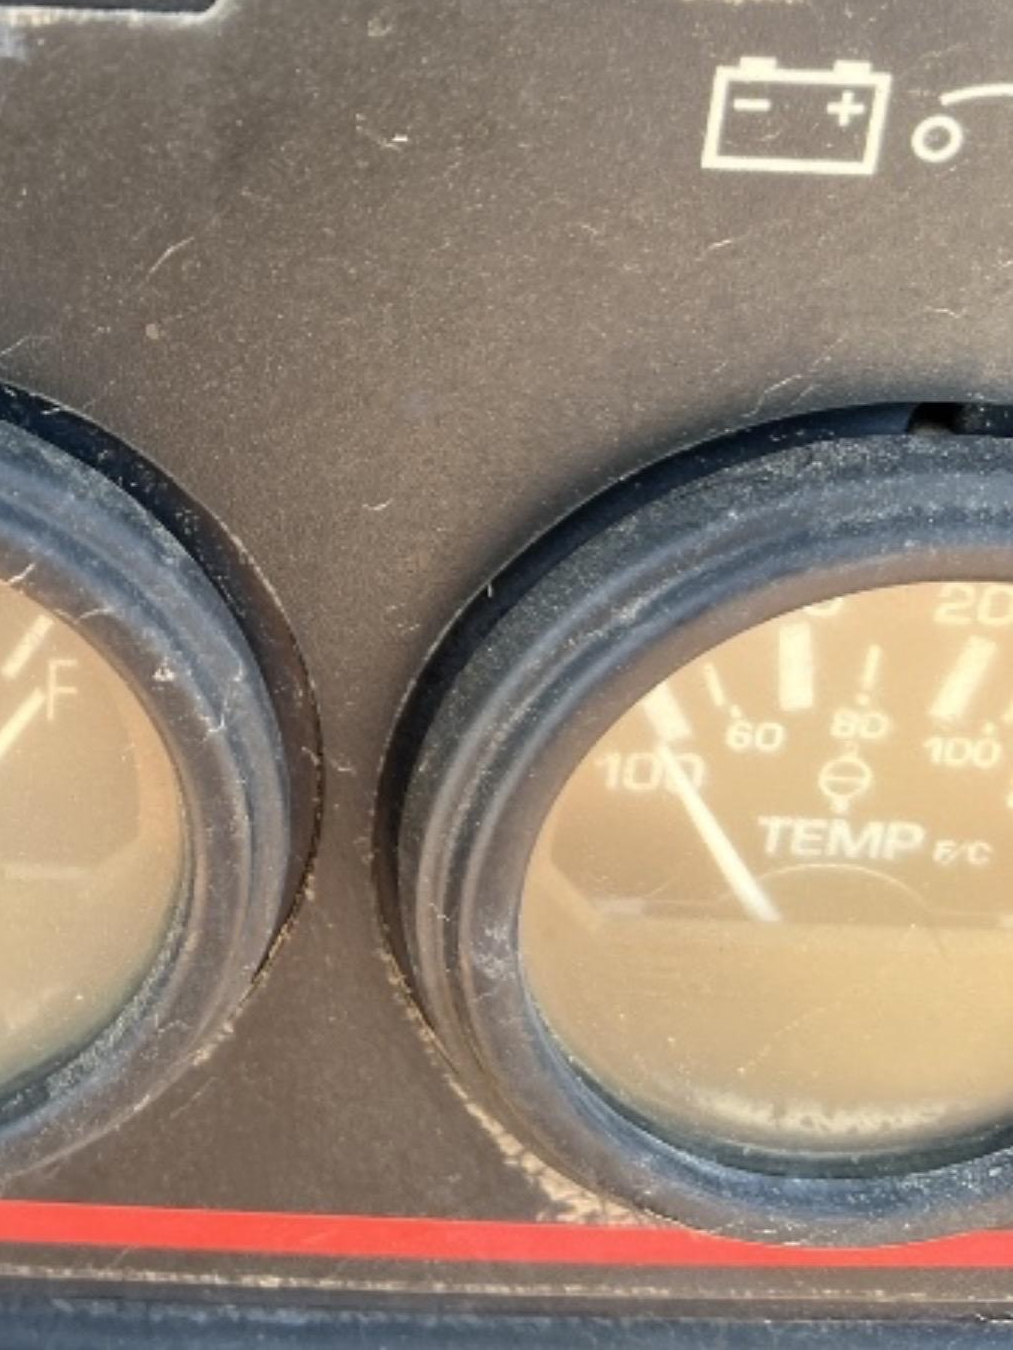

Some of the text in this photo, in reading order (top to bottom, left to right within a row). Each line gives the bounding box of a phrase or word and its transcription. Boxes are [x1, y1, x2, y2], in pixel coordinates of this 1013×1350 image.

[44, 658, 78, 721] F
[725, 720, 785, 753] 60
[829, 710, 889, 739] 80
[923, 736, 1002, 769] 100
[598, 751, 706, 791] 100
[758, 814, 926, 860] TEMP
